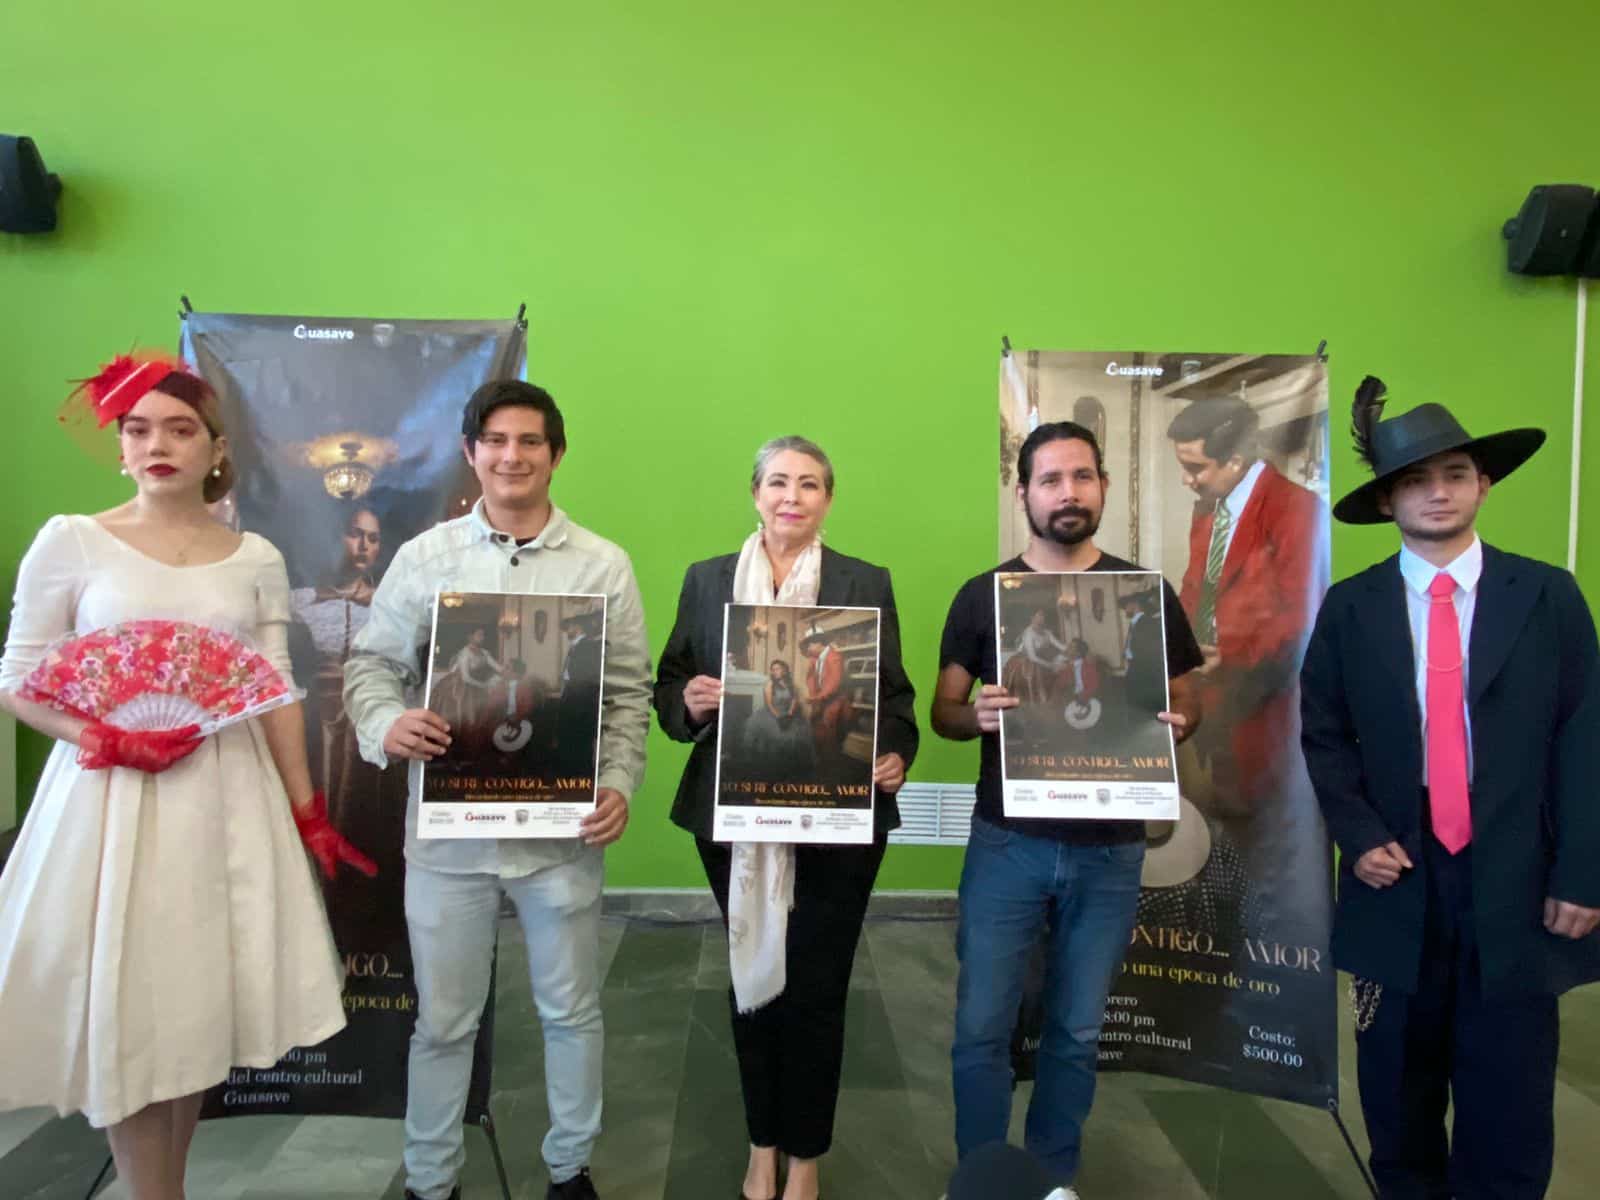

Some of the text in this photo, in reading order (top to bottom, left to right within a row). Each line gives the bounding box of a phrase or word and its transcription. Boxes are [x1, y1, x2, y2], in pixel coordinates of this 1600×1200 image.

[293, 323, 355, 340] Guasave
[1105, 361, 1164, 376] Guasave
[556, 777, 592, 791] AMOR
[1132, 961, 1164, 978] una
[1223, 971, 1244, 989] de
[1249, 977, 1281, 996] oro
[1134, 1013, 1156, 1028] pm
[1135, 1032, 1192, 1051] cultural
[1248, 1024, 1297, 1048] Costo:
[304, 1050, 328, 1064] pm
[1242, 1043, 1304, 1069] $500.00
[255, 1070, 301, 1084] centro
[304, 1069, 363, 1085] cultural
[223, 1090, 291, 1106] Guasave
